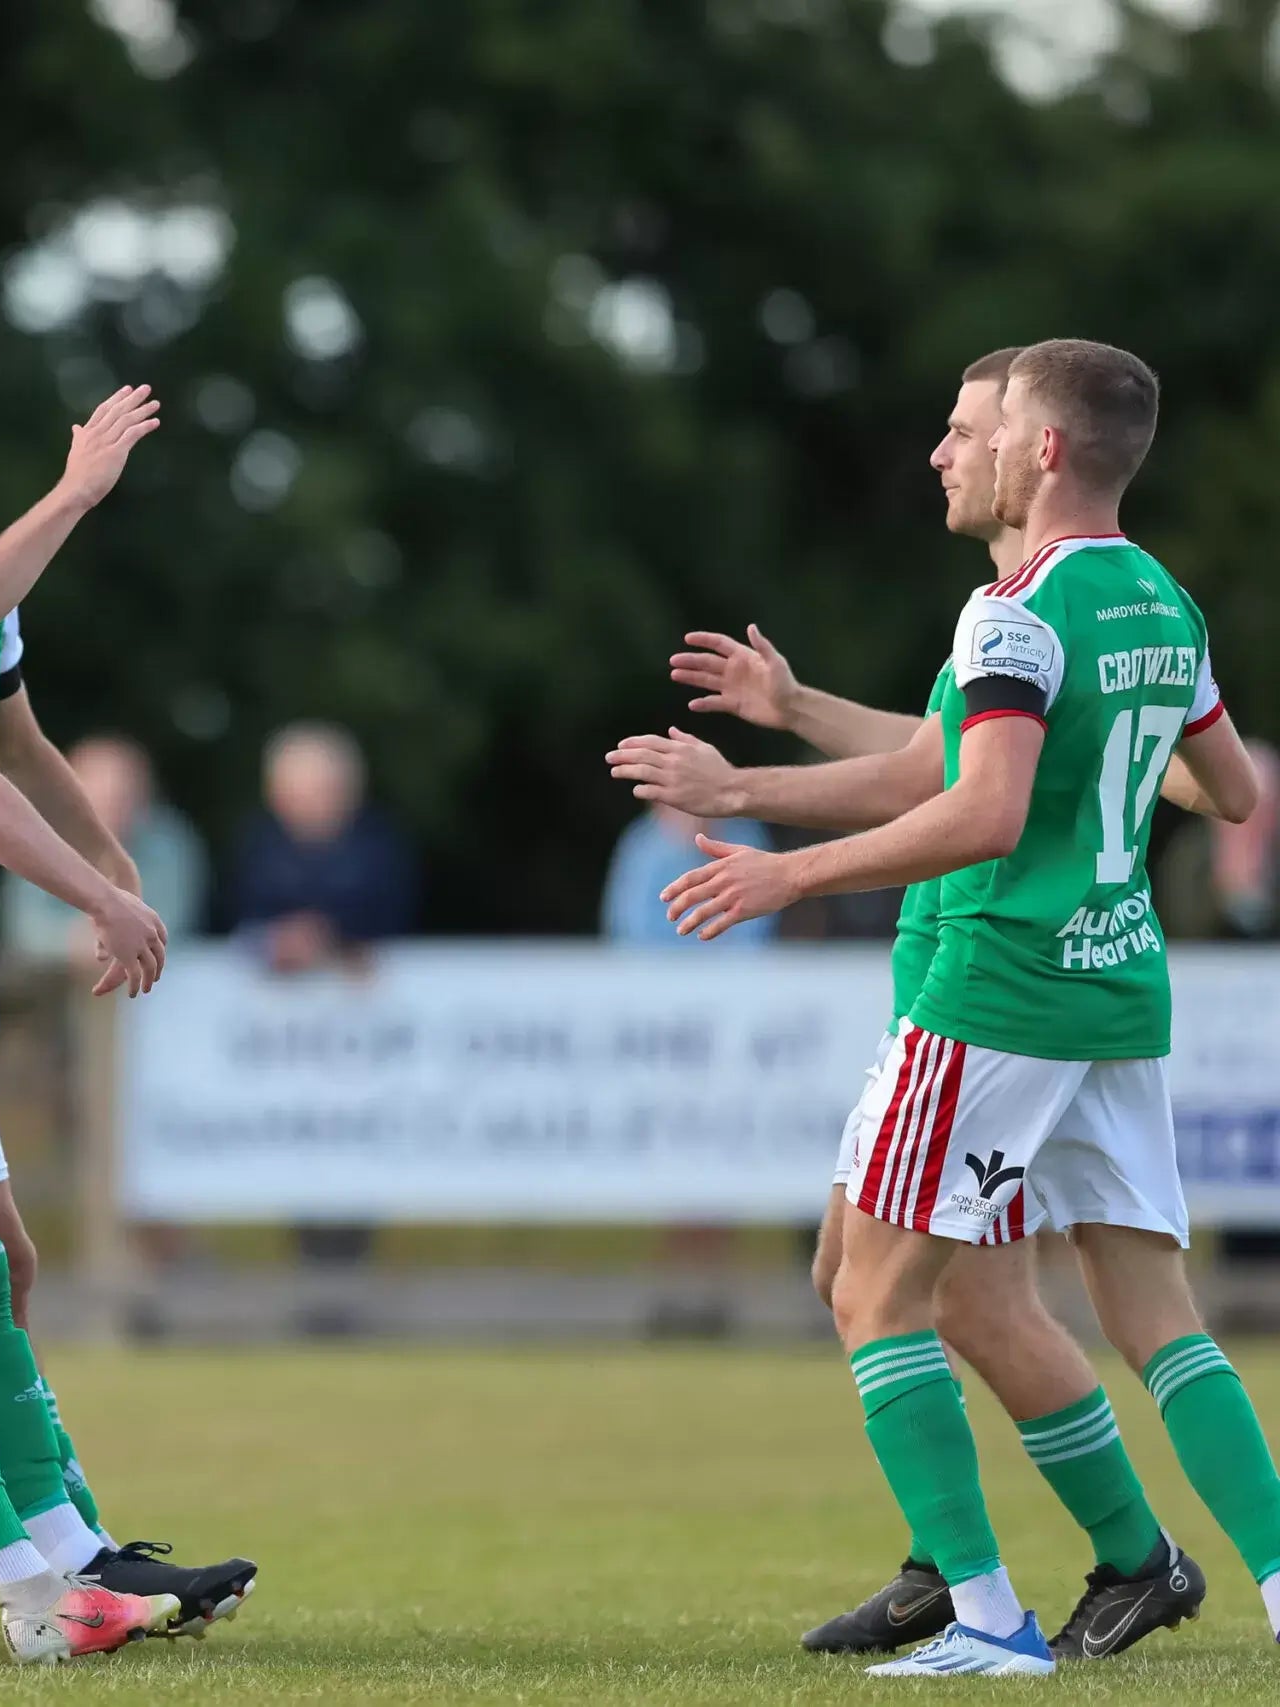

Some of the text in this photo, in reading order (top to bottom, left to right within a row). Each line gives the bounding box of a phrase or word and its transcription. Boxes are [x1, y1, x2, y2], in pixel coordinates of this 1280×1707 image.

[1095, 602, 1148, 622] MARDYKE
[1007, 631, 1031, 644] sse
[1005, 642, 1047, 661] Airtricity
[984, 659, 1037, 672] FIRST DIVISION
[1097, 646, 1197, 694] CROWLEY
[1095, 705, 1190, 884] 17
[951, 1193, 973, 1206] BON
[959, 1205, 997, 1221] HOSPITA
